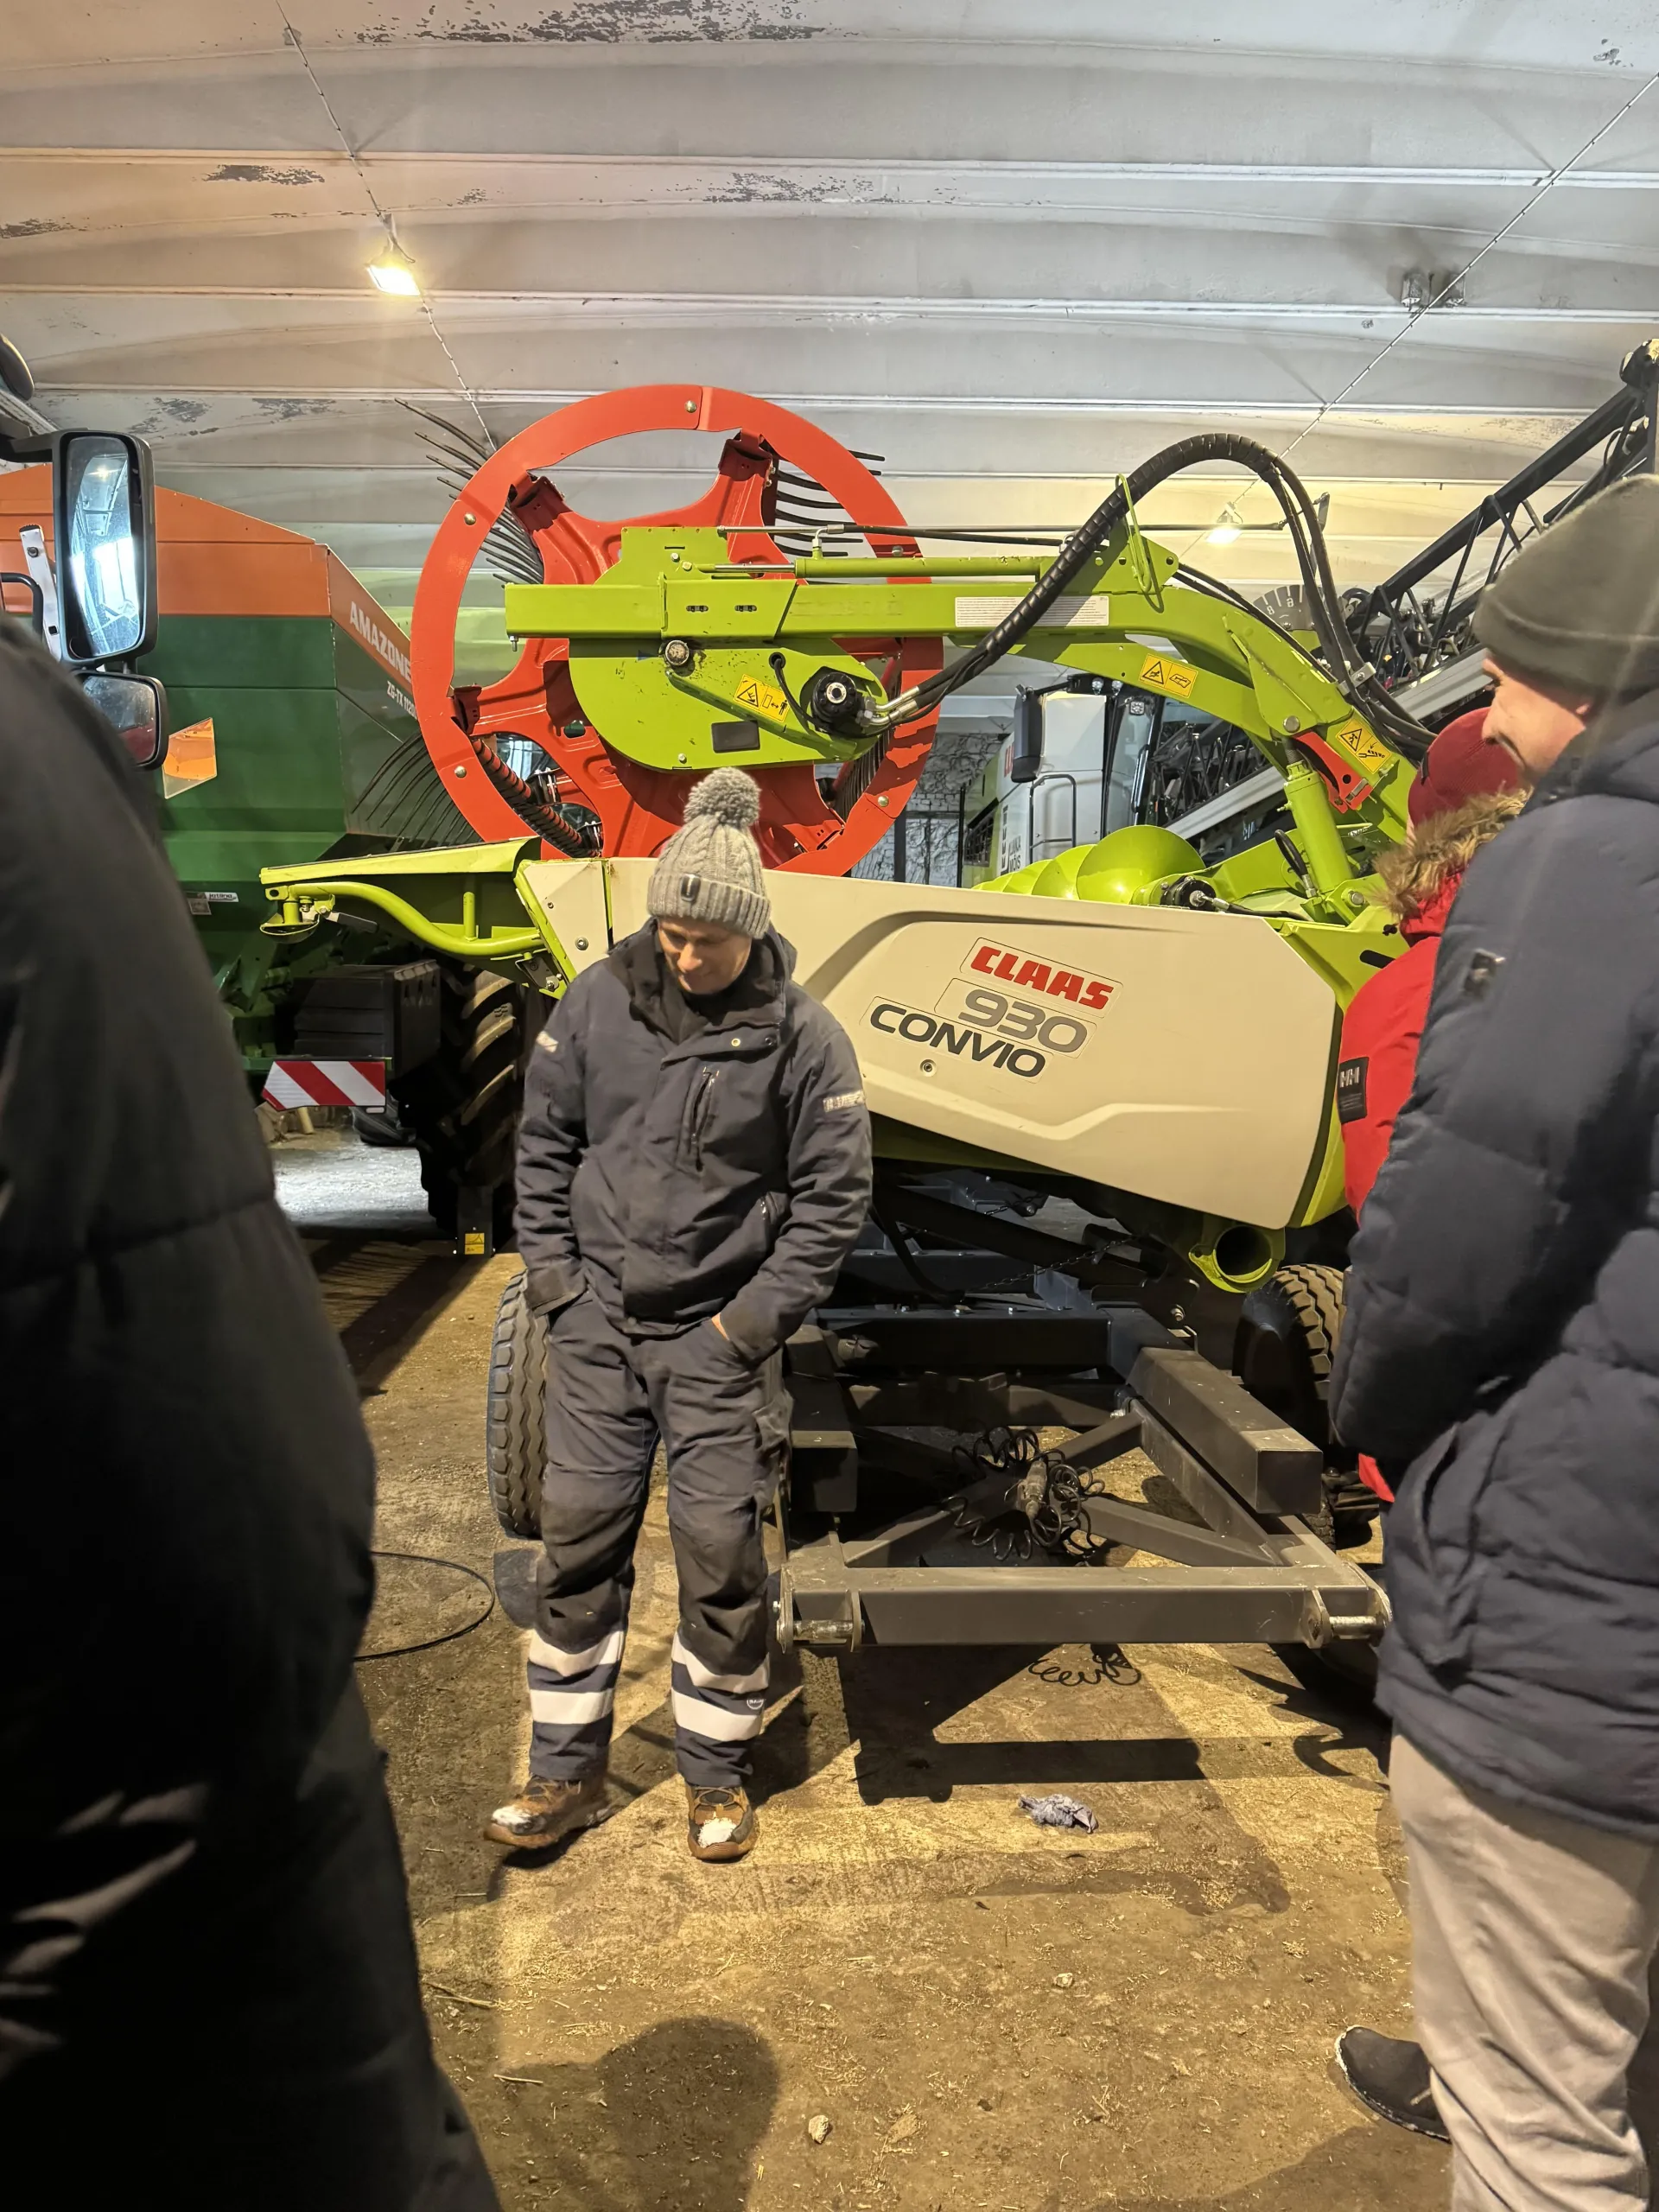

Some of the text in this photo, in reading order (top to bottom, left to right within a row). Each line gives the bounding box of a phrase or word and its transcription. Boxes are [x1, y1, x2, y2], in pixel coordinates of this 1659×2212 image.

[349, 601, 412, 683] AMAZONE
[970, 945, 1115, 1010] CLAAS
[870, 1003, 1046, 1077] CONVIO
[957, 988, 1088, 1053] 930
